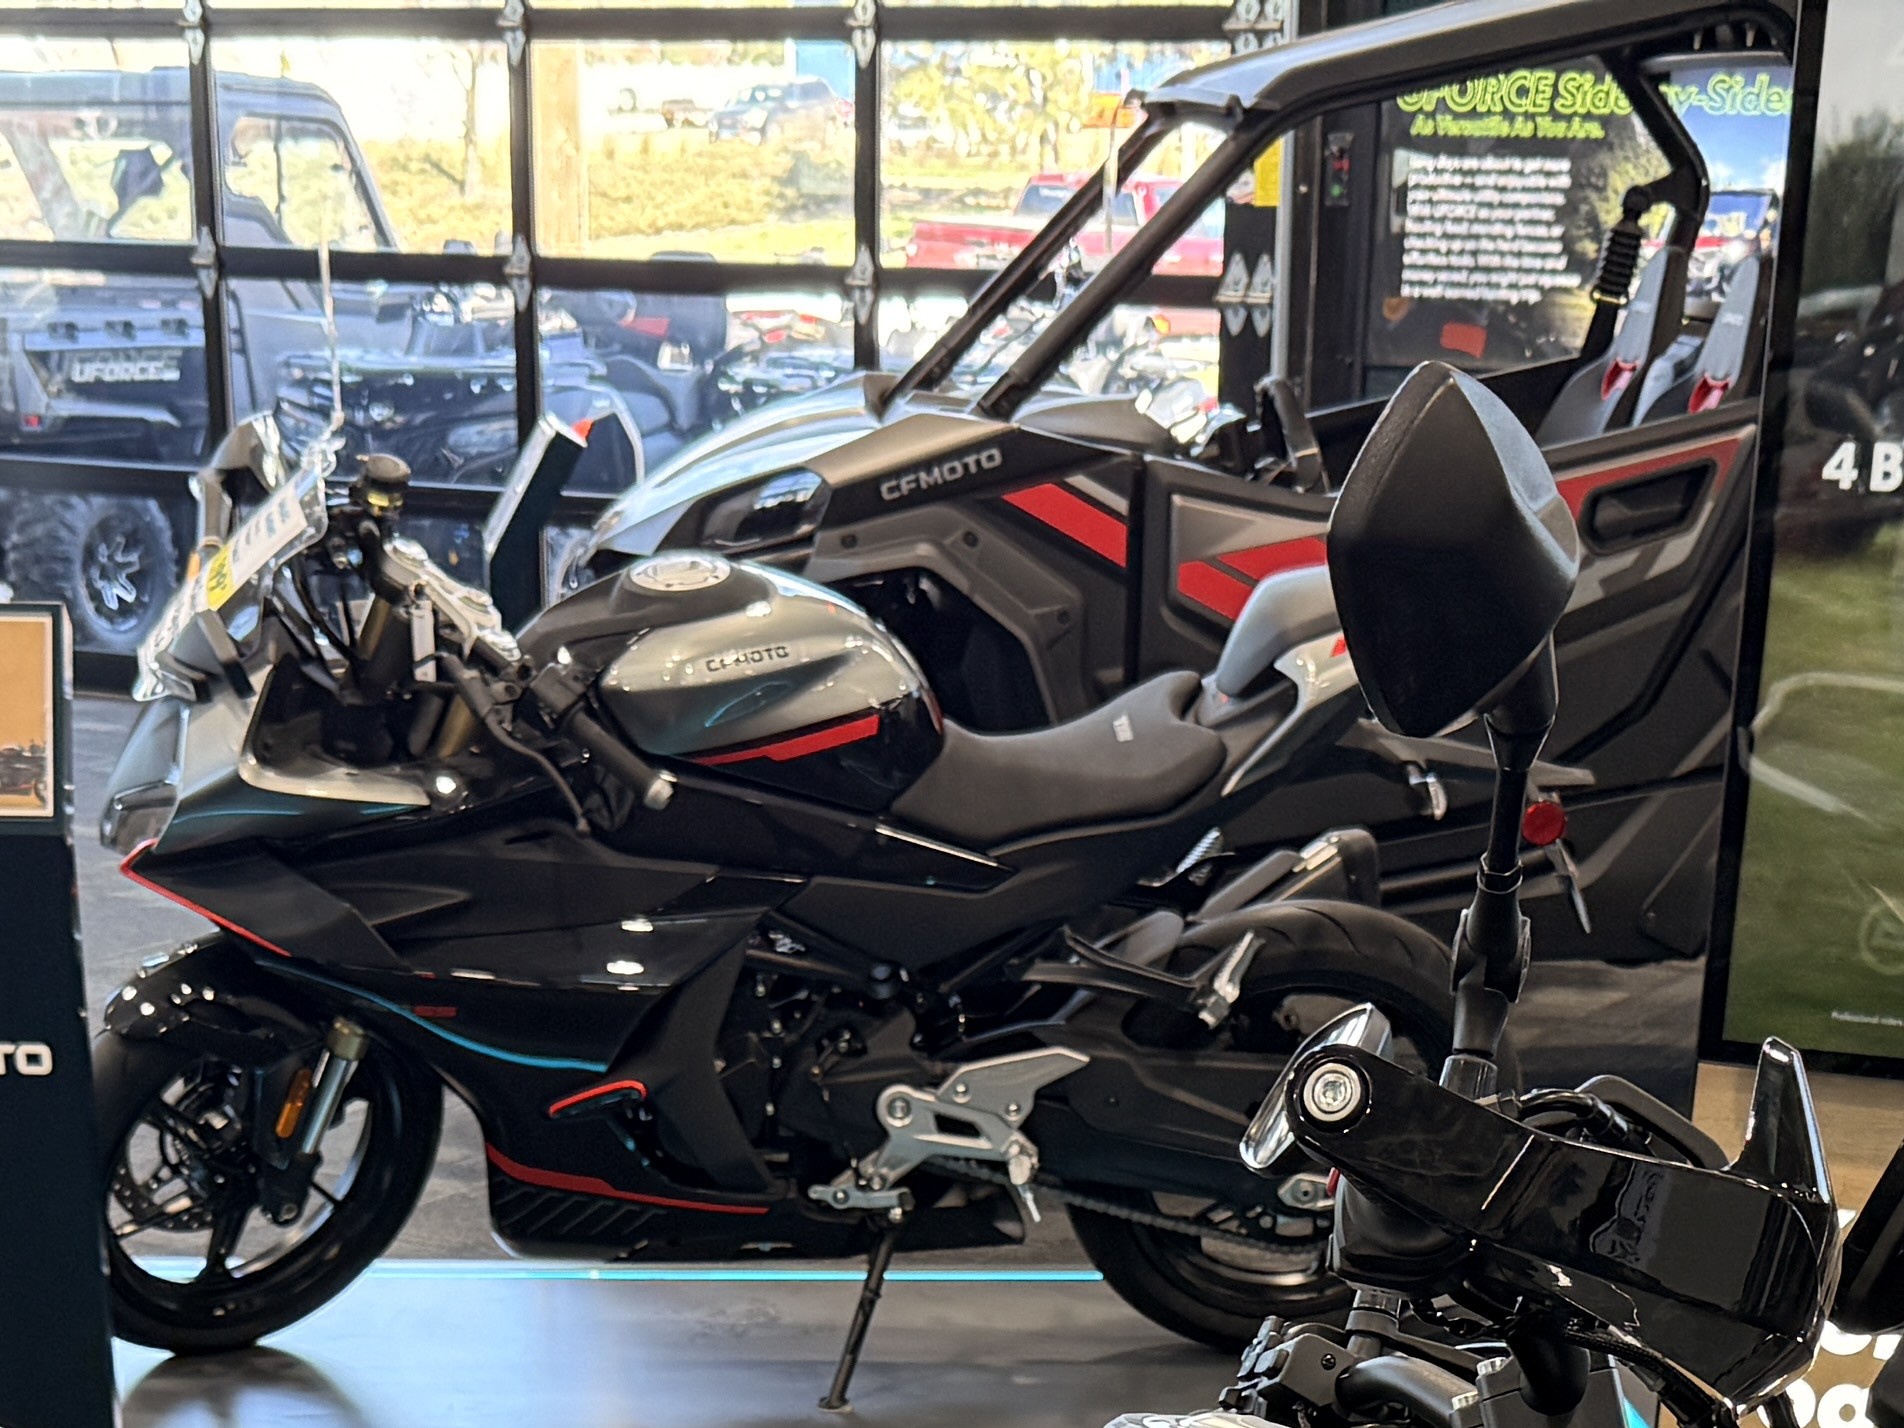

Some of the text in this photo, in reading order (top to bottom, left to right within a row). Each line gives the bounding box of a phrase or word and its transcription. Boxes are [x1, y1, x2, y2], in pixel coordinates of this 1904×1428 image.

[879, 447, 1004, 501] CFMOTO
[1821, 442, 1859, 491] 4
[705, 644, 790, 674] CFMOTO
